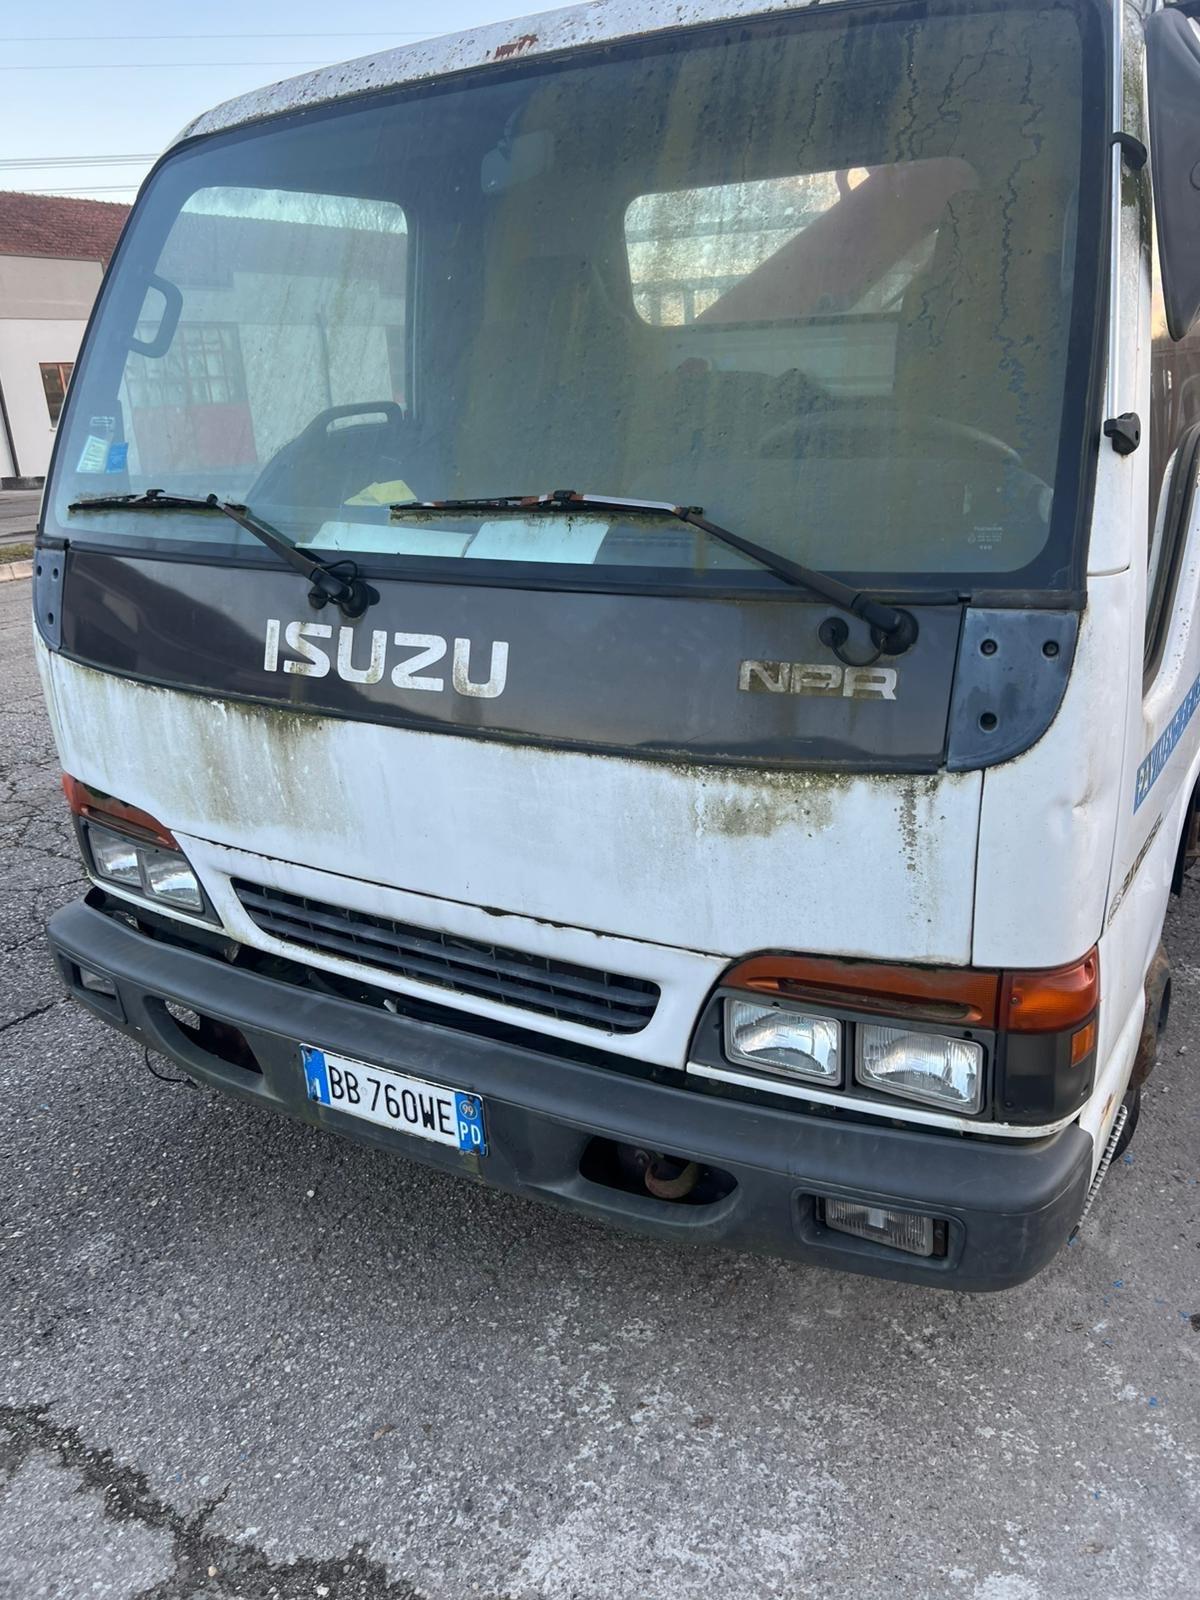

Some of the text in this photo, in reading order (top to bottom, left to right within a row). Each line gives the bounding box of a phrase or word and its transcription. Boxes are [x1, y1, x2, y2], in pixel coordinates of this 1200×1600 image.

[263, 618, 509, 699] ISUZU
[739, 660, 897, 700] NPR
[328, 1065, 455, 1136] BB 760WE
[462, 1104, 474, 1116] 99
[460, 1121, 482, 1145] PD
